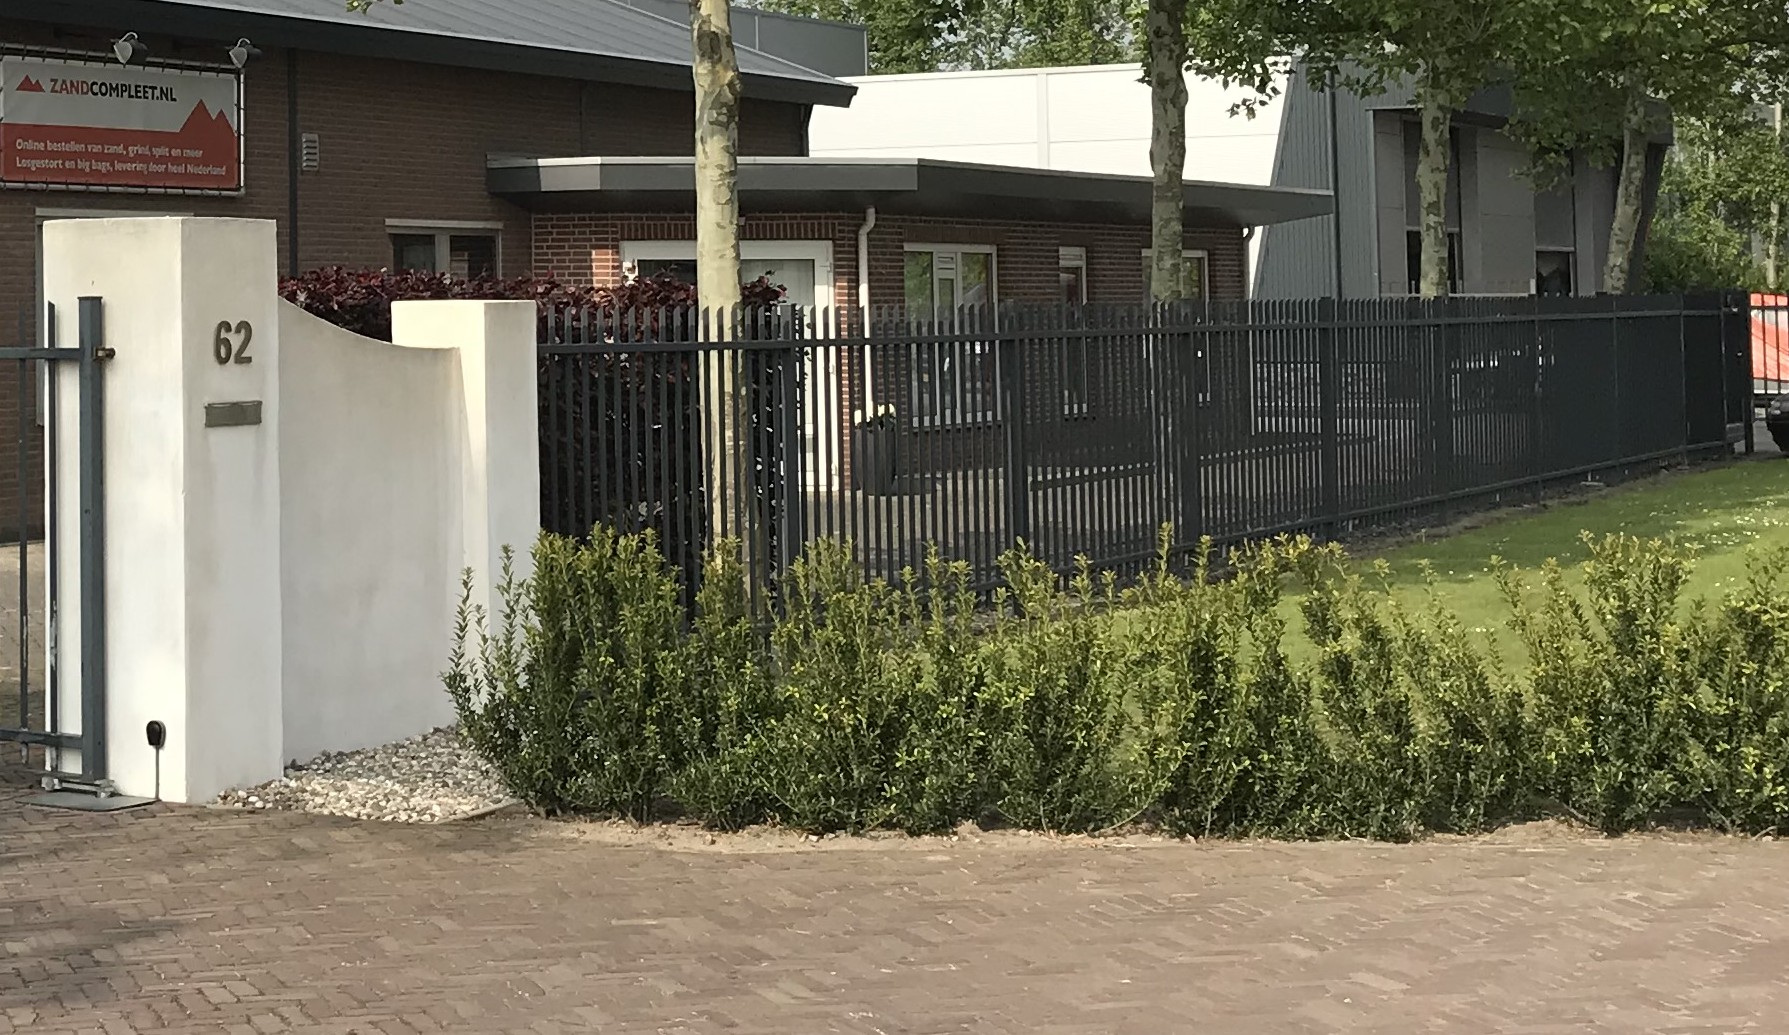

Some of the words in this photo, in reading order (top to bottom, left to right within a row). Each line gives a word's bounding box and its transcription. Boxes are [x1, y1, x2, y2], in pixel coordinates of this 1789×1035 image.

[50, 78, 177, 102] ZANDCOMPLEET.NL
[16, 139, 44, 151] Online
[47, 140, 85, 152] bestellen
[88, 145, 102, 153] van
[171, 148, 181, 157] en
[16, 156, 62, 171] Losgestort
[65, 160, 75, 169] en
[77, 158, 90, 173] big
[187, 164, 227, 176] Nederland
[214, 321, 253, 365] 62
